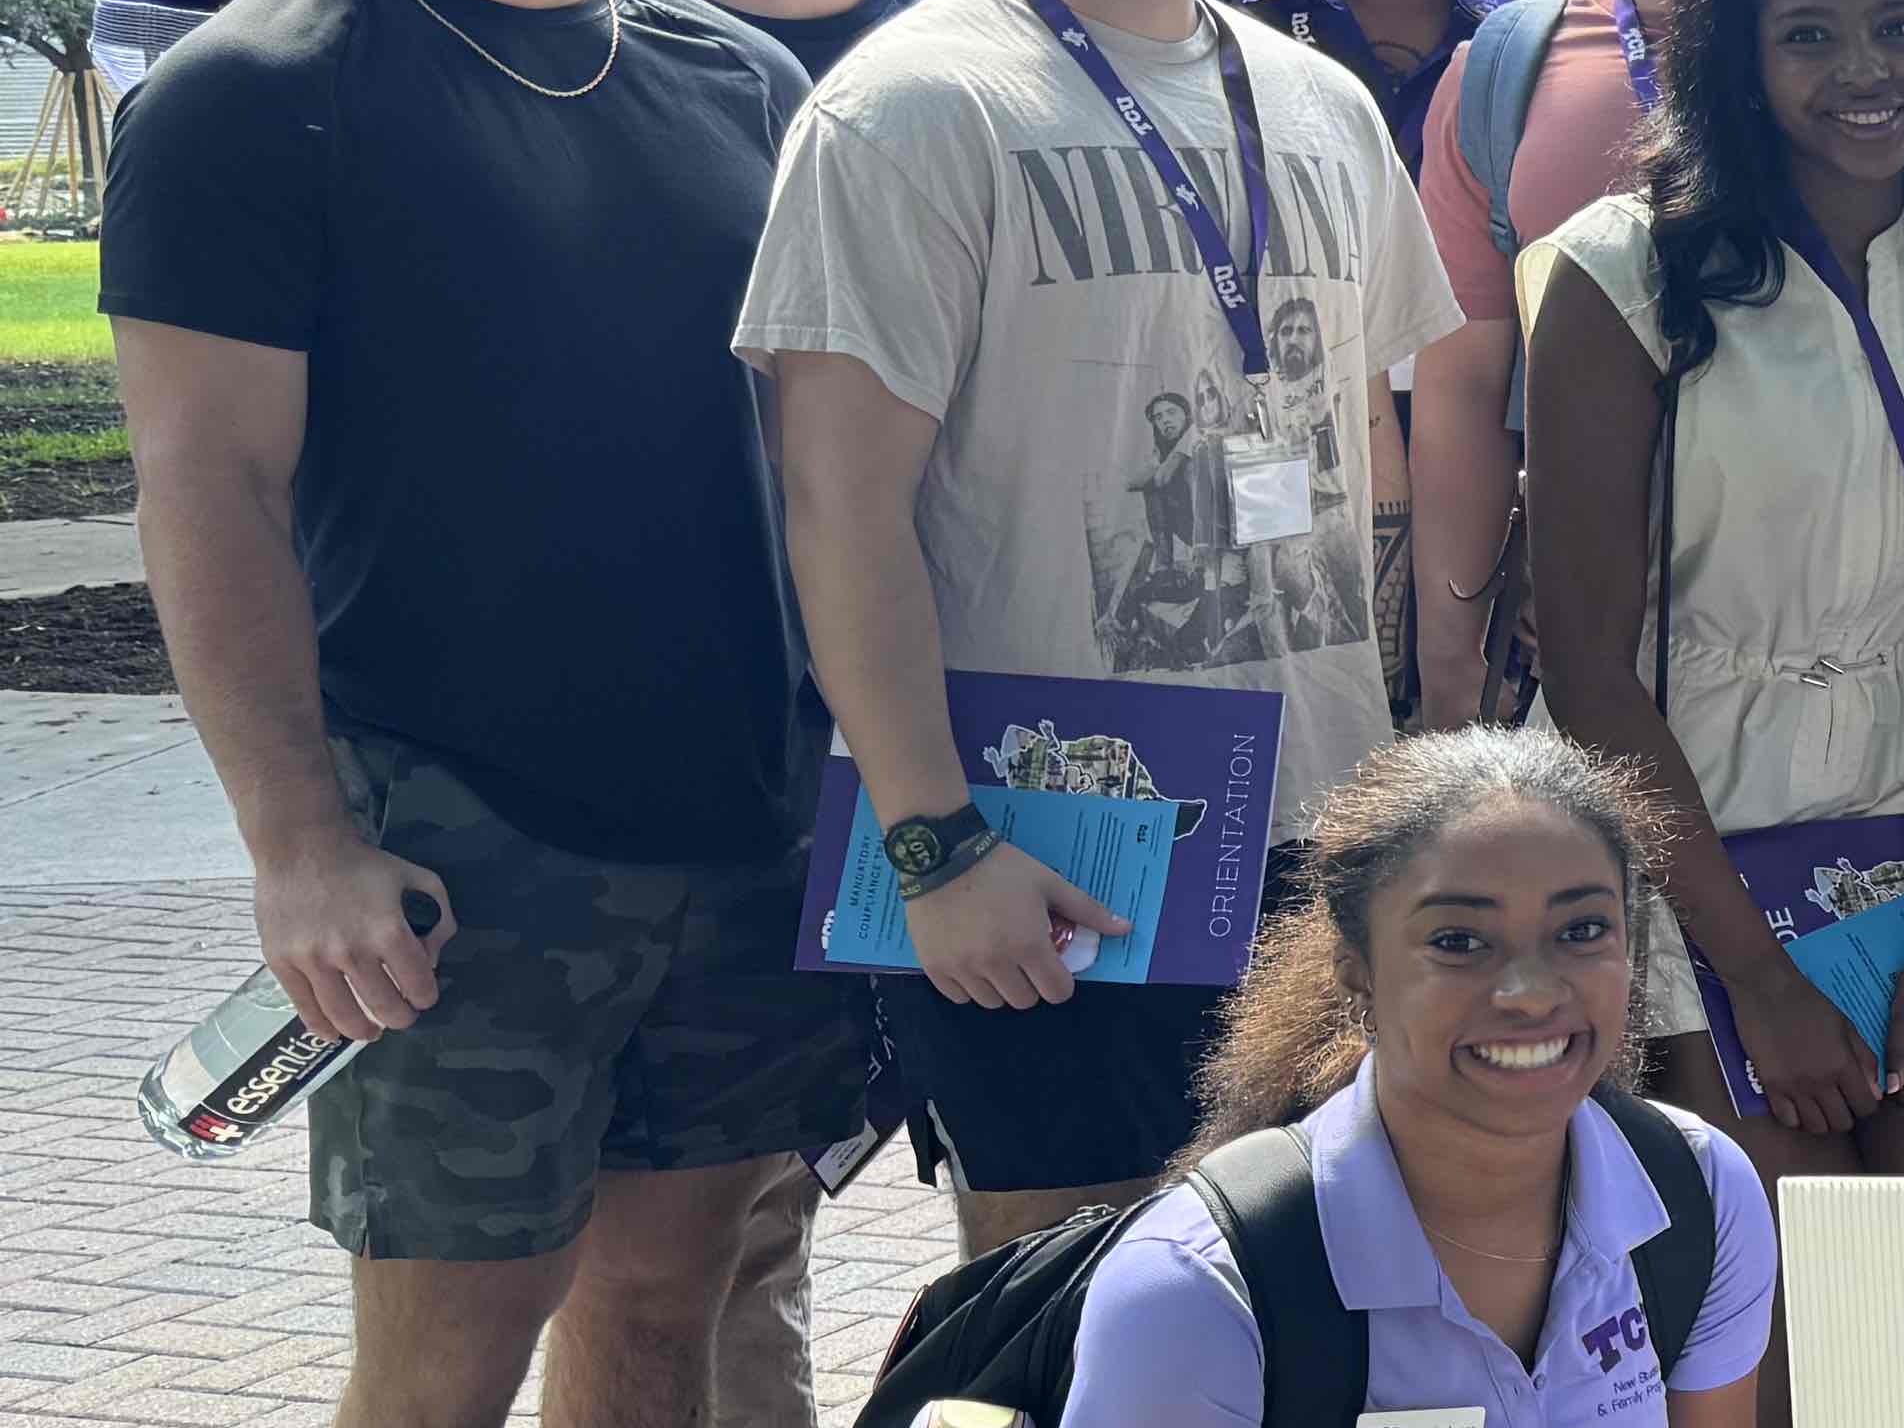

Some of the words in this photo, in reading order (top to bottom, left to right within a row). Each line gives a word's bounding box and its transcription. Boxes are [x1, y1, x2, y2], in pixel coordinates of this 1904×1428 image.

[1116, 96, 1153, 135] TCU
[1214, 264, 1247, 309] TCU
[1208, 733, 1256, 938] ORIENTATION
[1581, 1306, 1647, 1374] TC
[1597, 1403, 1608, 1418] &
